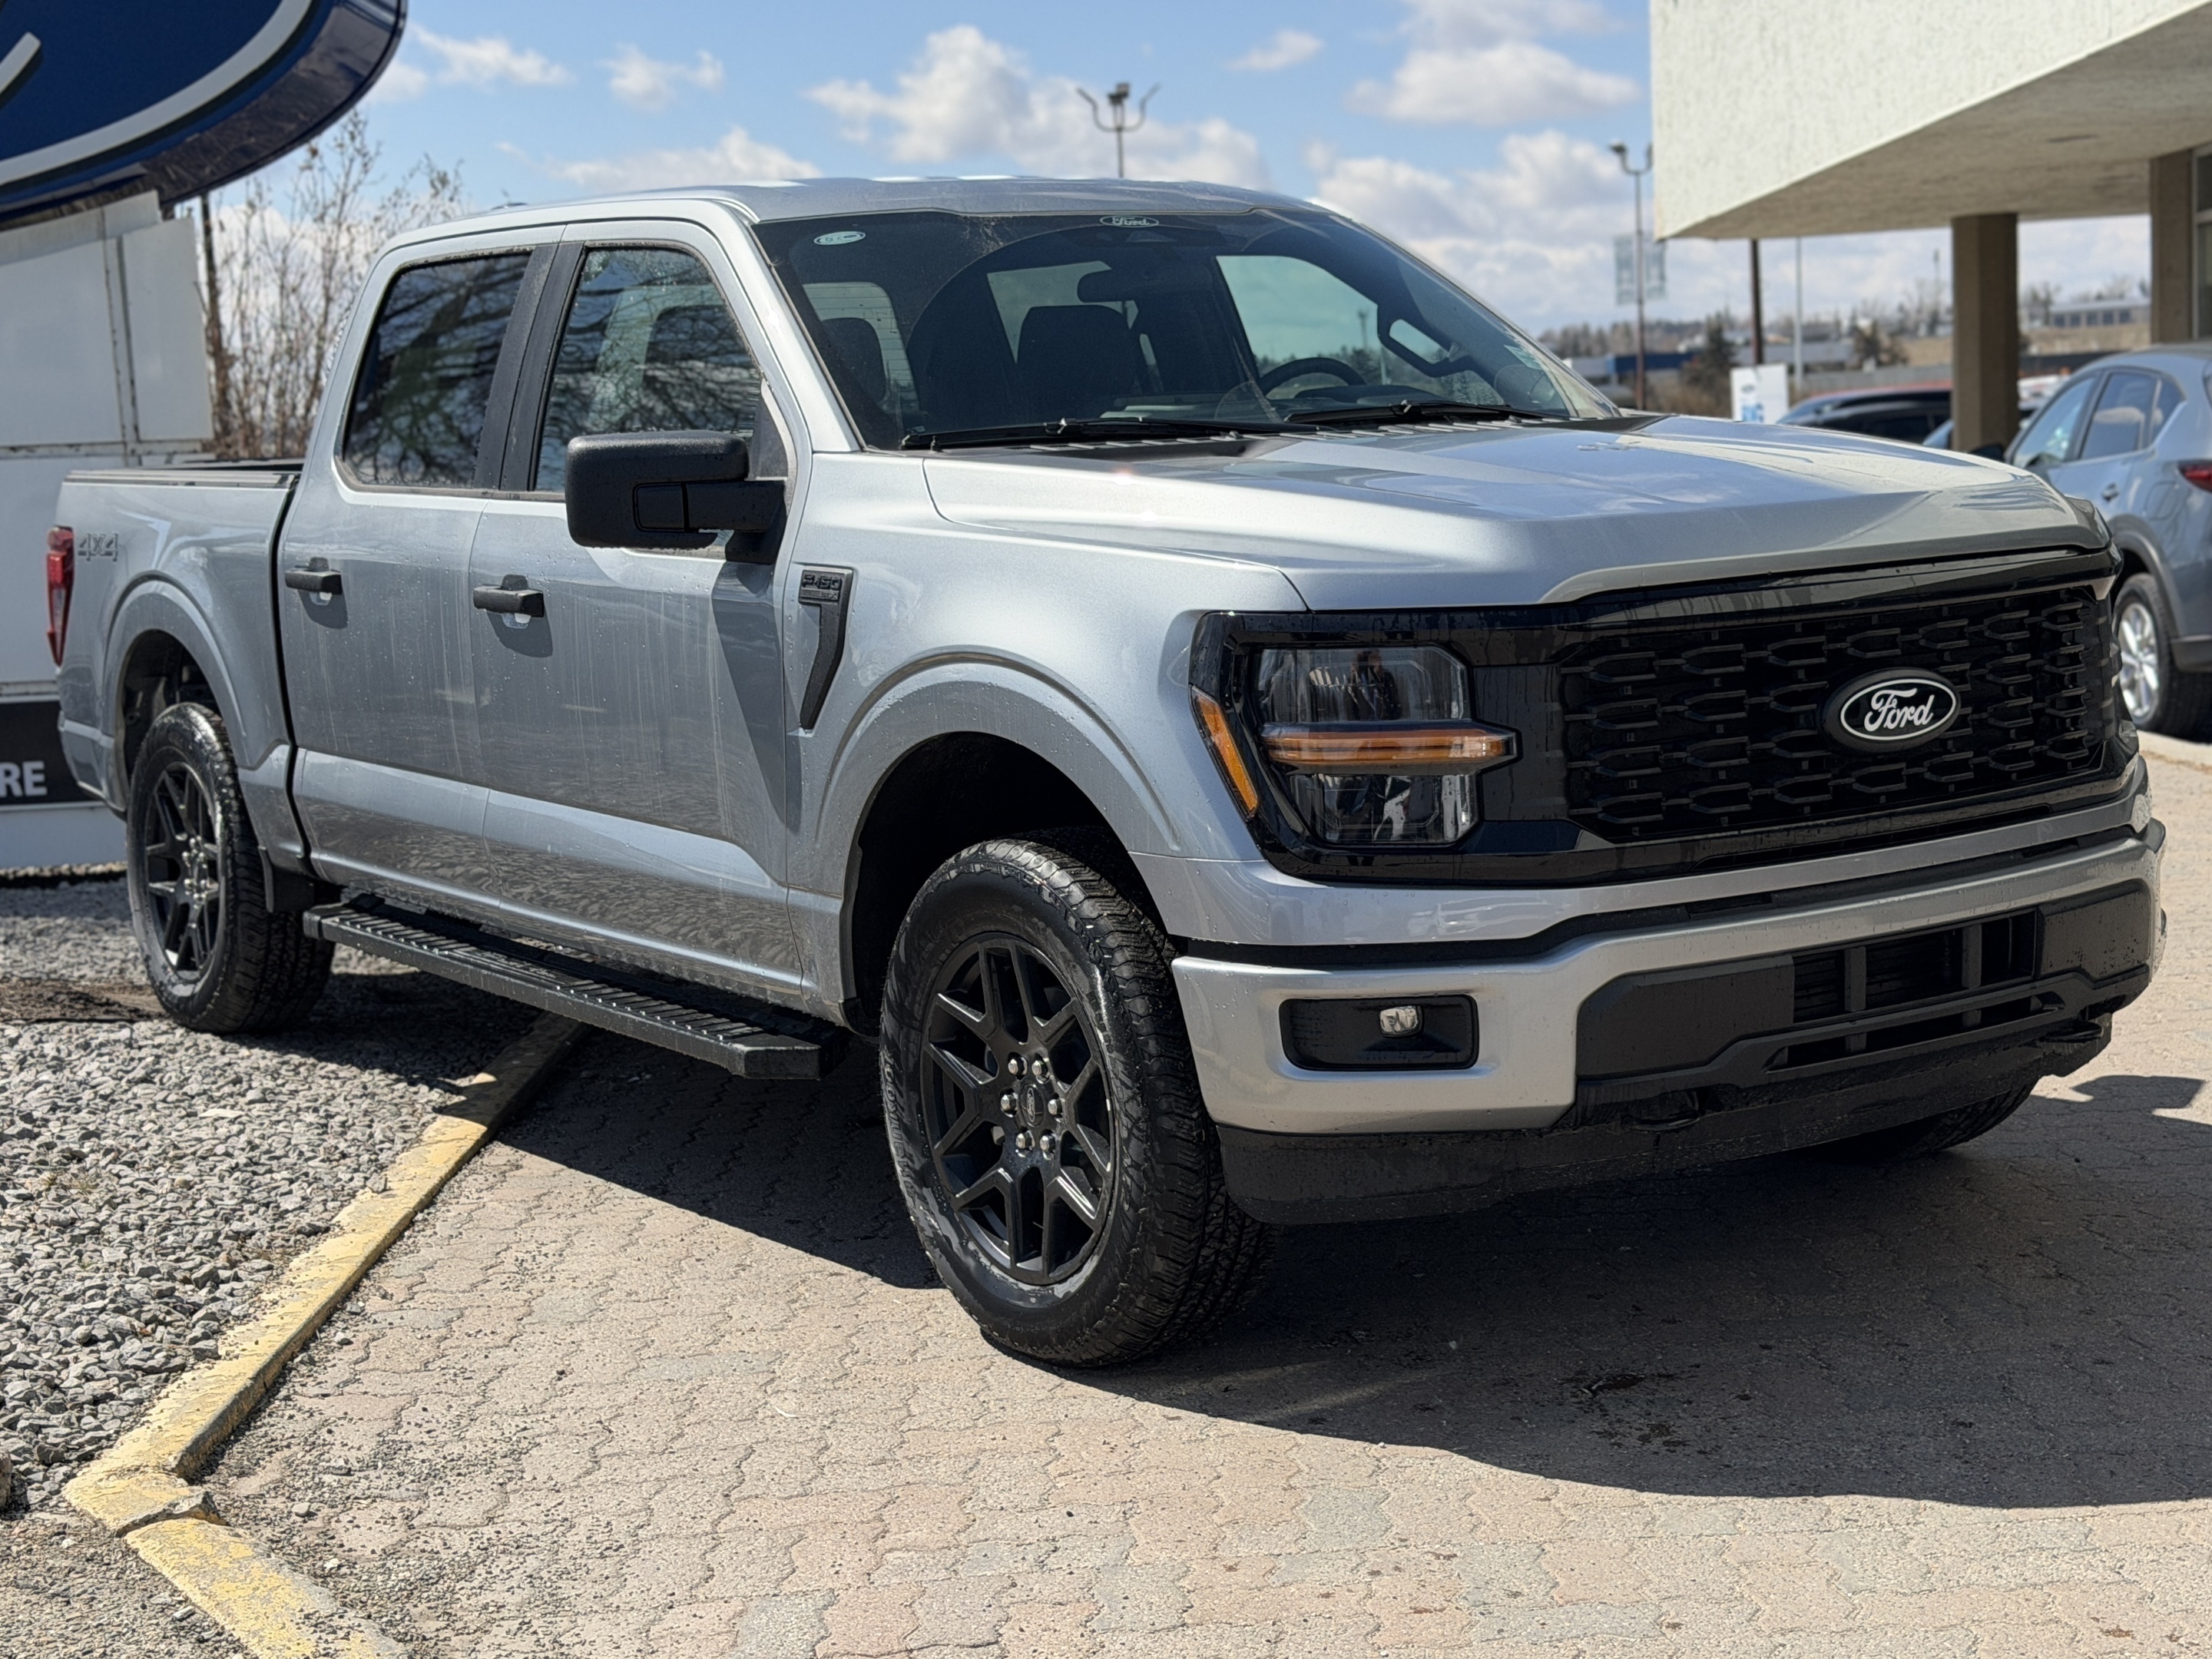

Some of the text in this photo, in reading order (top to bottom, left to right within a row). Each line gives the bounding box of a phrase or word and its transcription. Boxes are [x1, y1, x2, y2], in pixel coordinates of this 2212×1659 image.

[1111, 217, 1151, 227] Ford
[1863, 687, 1936, 732] Ford
[0, 760, 48, 797] RE
